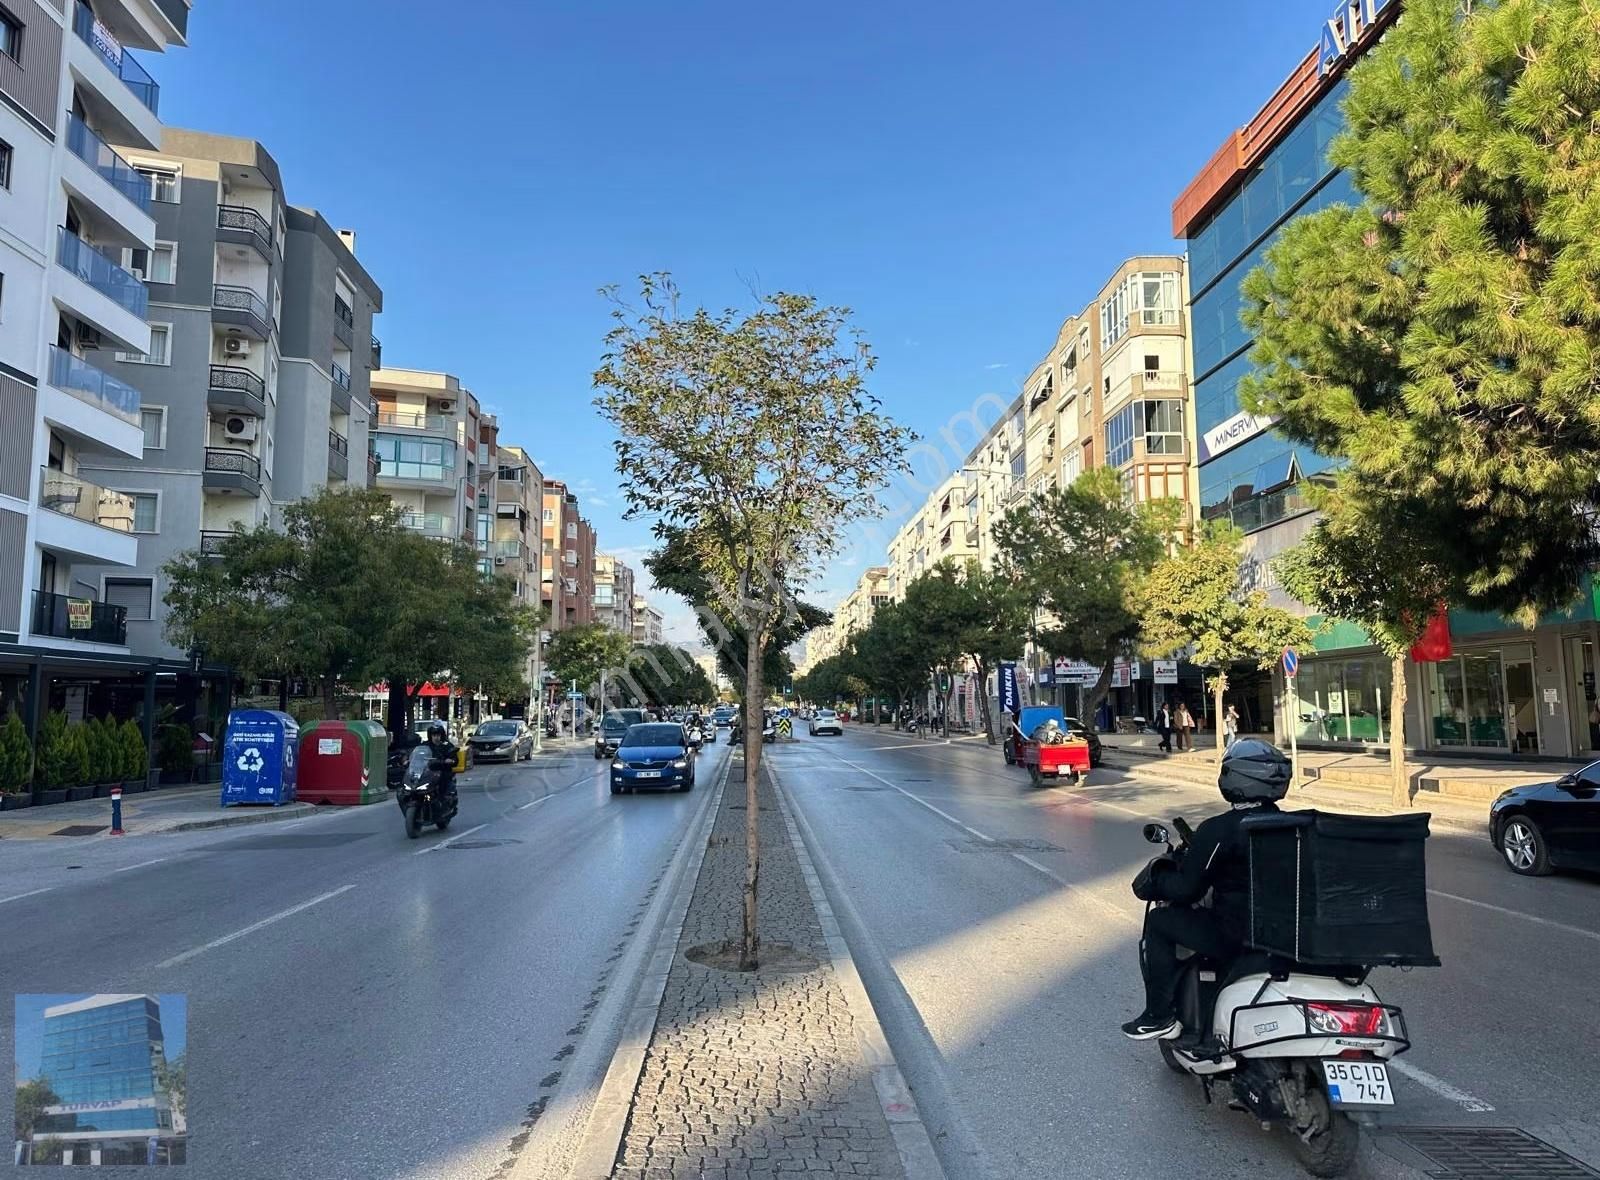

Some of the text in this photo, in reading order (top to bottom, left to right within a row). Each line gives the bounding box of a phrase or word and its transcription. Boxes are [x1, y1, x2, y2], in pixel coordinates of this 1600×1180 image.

[1214, 414, 1260, 449] MINERVA
[1004, 668, 1013, 706] DAIKIN
[1356, 1084, 1385, 1101] 747
